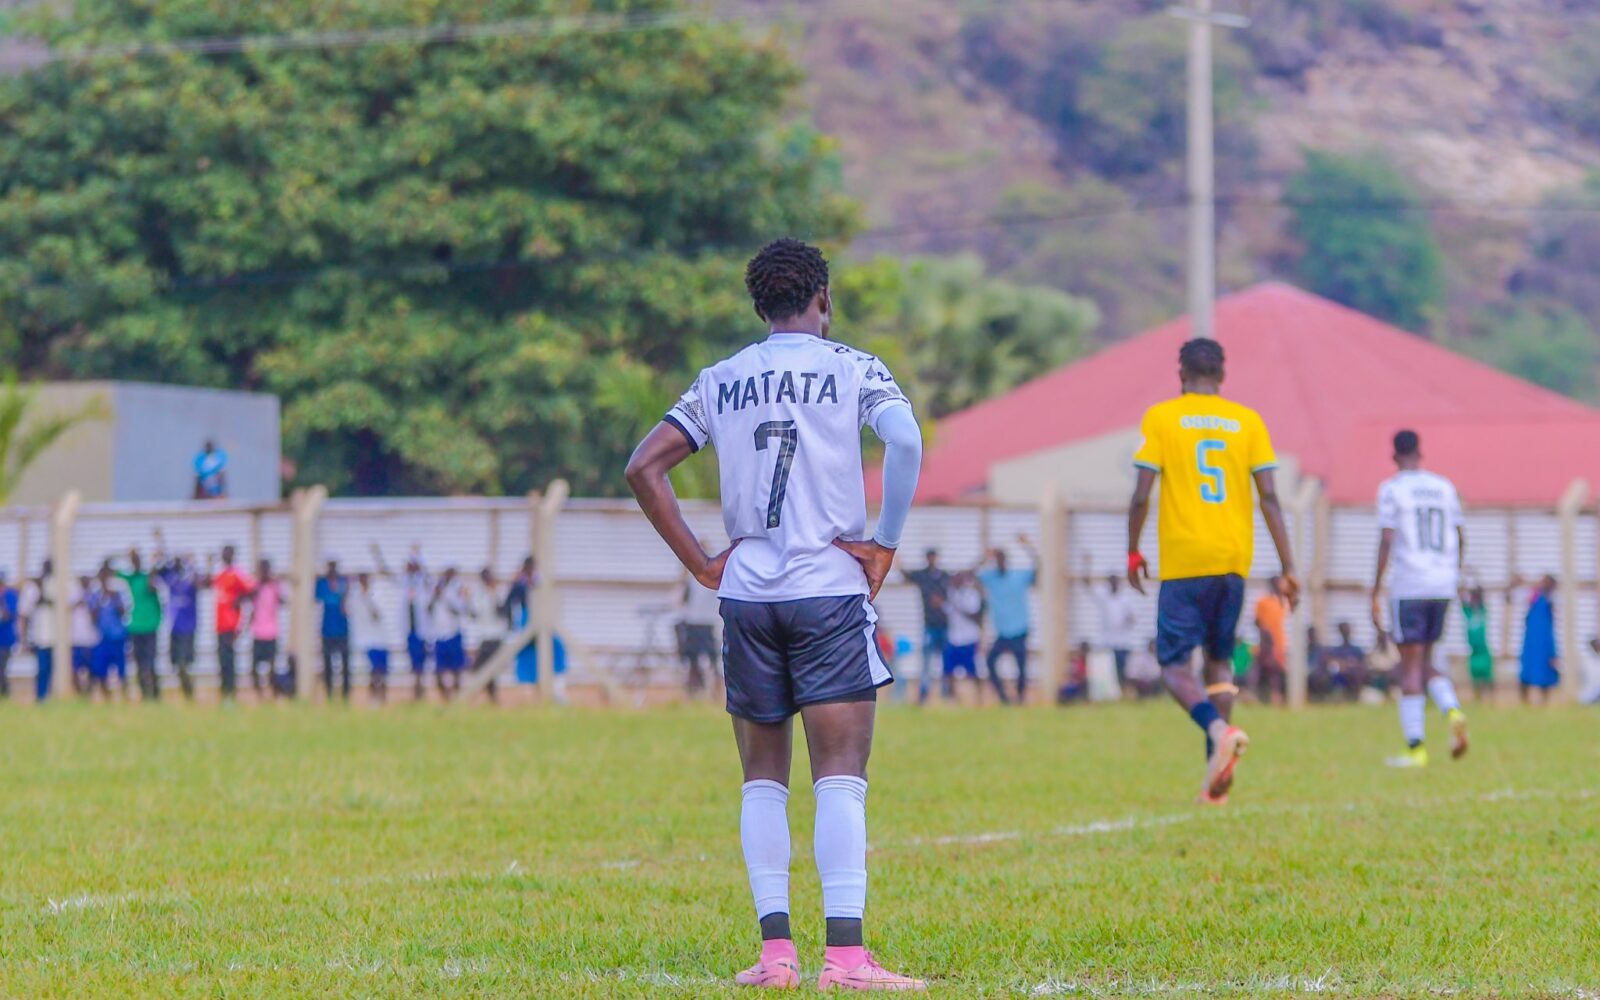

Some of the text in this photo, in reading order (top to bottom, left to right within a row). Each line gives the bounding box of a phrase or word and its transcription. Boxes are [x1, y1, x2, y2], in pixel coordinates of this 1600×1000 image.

[717, 370, 838, 414] MATATA
[753, 420, 798, 529] 7
[1196, 439, 1226, 503] 5
[1415, 507, 1444, 553] 10
